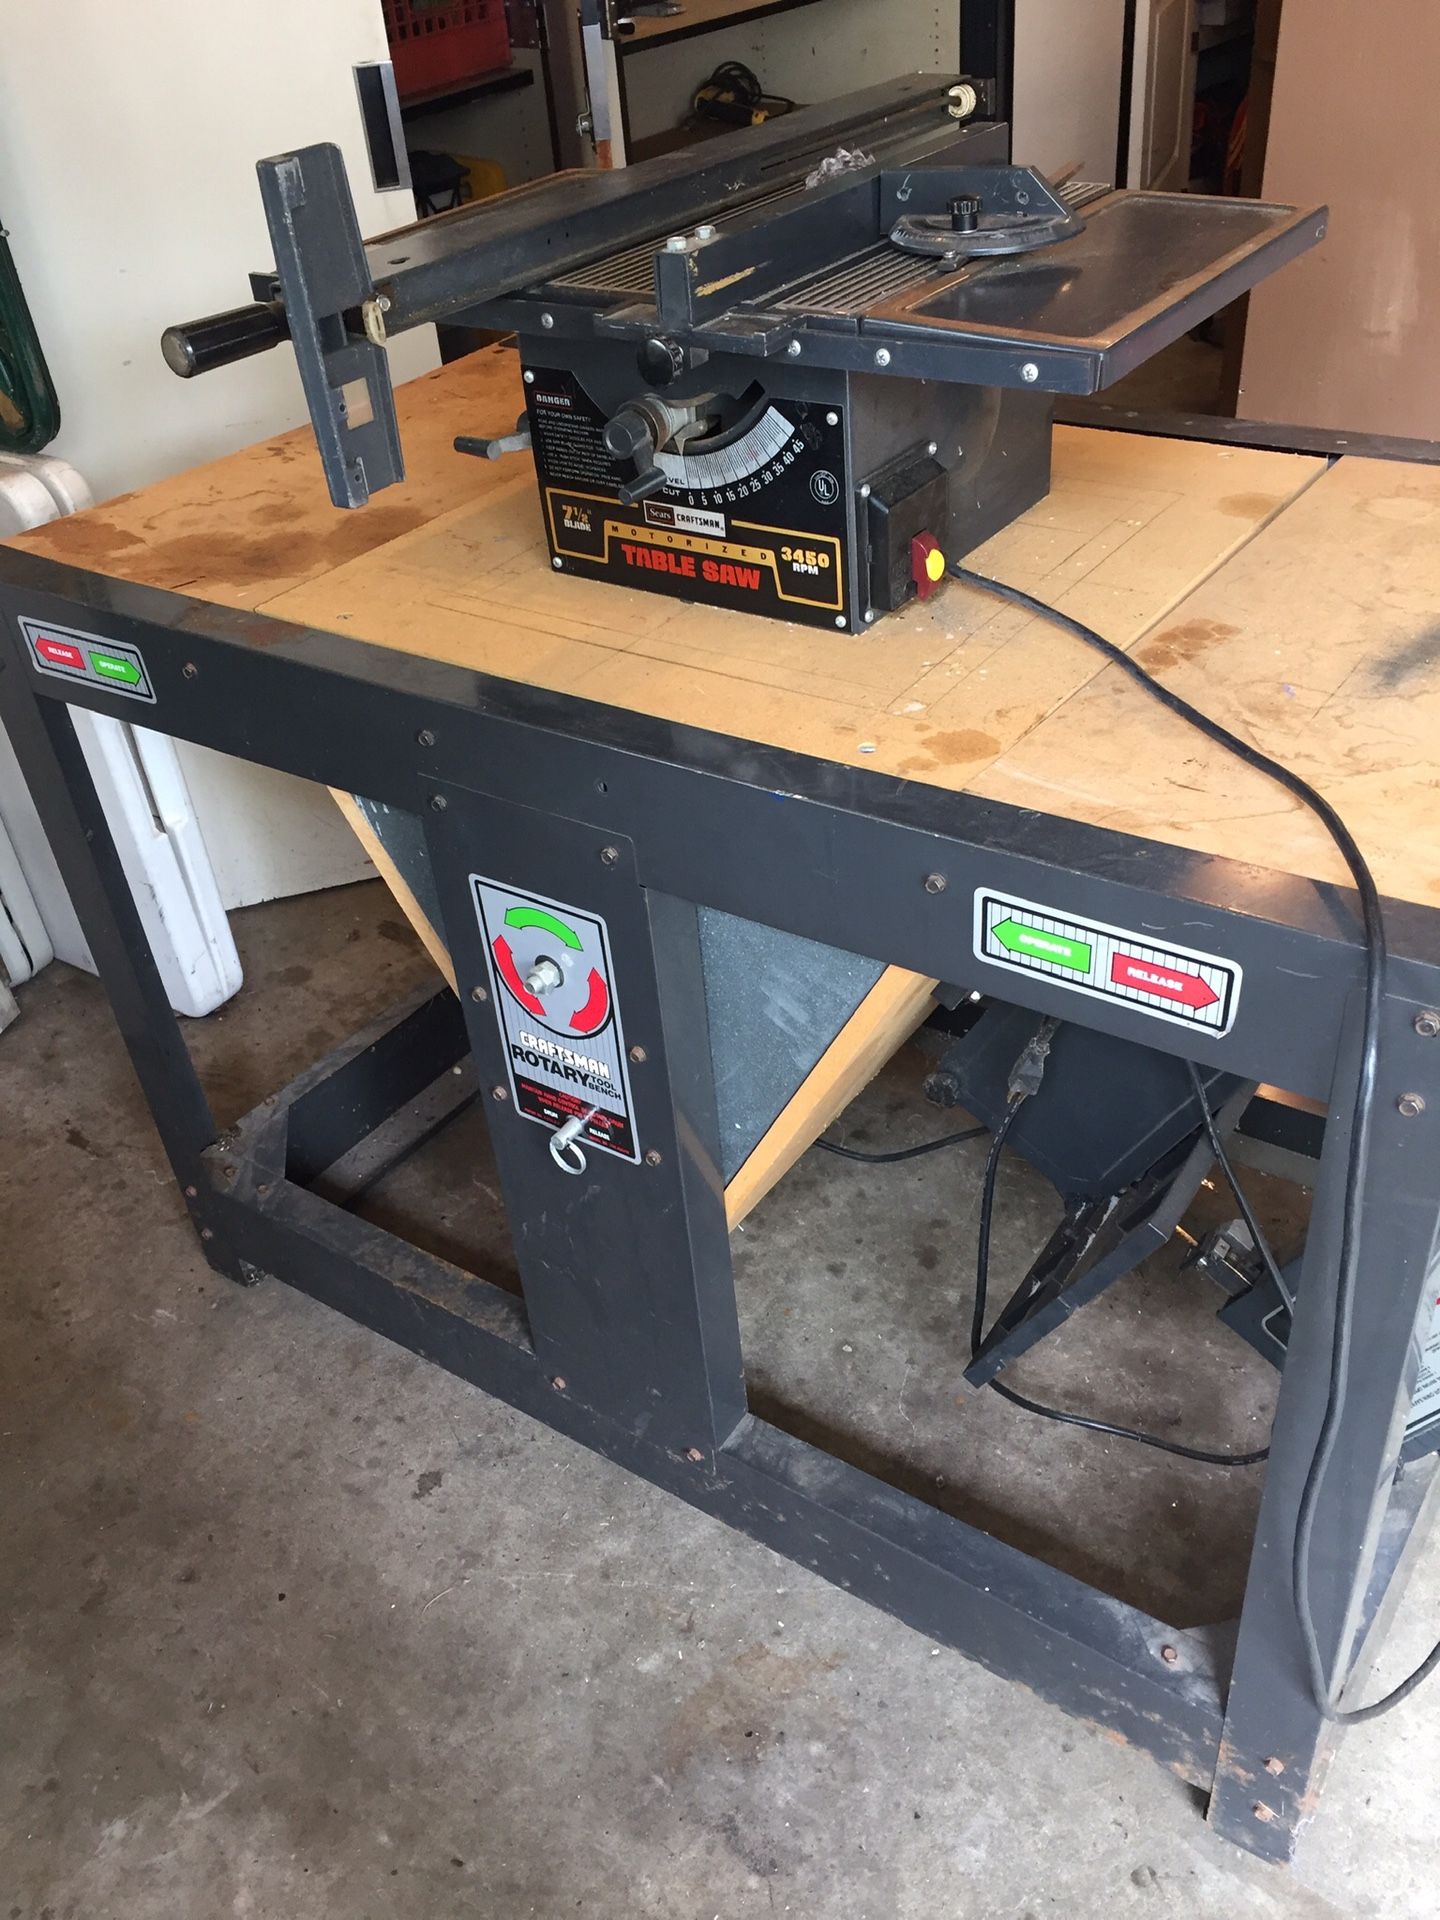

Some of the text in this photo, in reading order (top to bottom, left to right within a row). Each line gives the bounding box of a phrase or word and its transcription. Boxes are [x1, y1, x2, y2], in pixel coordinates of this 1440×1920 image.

[536, 394, 571, 406] DANGER
[536, 409, 547, 418] FOR
[548, 411, 561, 419] YOUR
[561, 412, 573, 420] OWN
[713, 494, 723, 505] 10
[726, 491, 736, 502] 15
[737, 486, 749, 498] 20
[750, 480, 762, 492] 25
[761, 473, 774, 485] 30
[772, 464, 785, 477] 35
[782, 454, 795, 466] 40
[792, 440, 805, 454] 45
[662, 487, 681, 497] CUT
[563, 519, 592, 532] BLADE
[649, 506, 721, 530] Sears CRAFTSMAN
[621, 543, 761, 591] TABLE SAW
[781, 545, 830, 568] 3450
[792, 561, 819, 576] RPM
[47, 646, 74, 660] RELEASE
[99, 660, 127, 674] OPERATE
[1018, 933, 1072, 958] OPERATE
[1125, 965, 1184, 992] RELEASE
[520, 1030, 611, 1079] CRAFTSMAN
[511, 1043, 590, 1088] ROTARY
[591, 1074, 617, 1092] TOOL
[588, 1082, 622, 1101] BENCH
